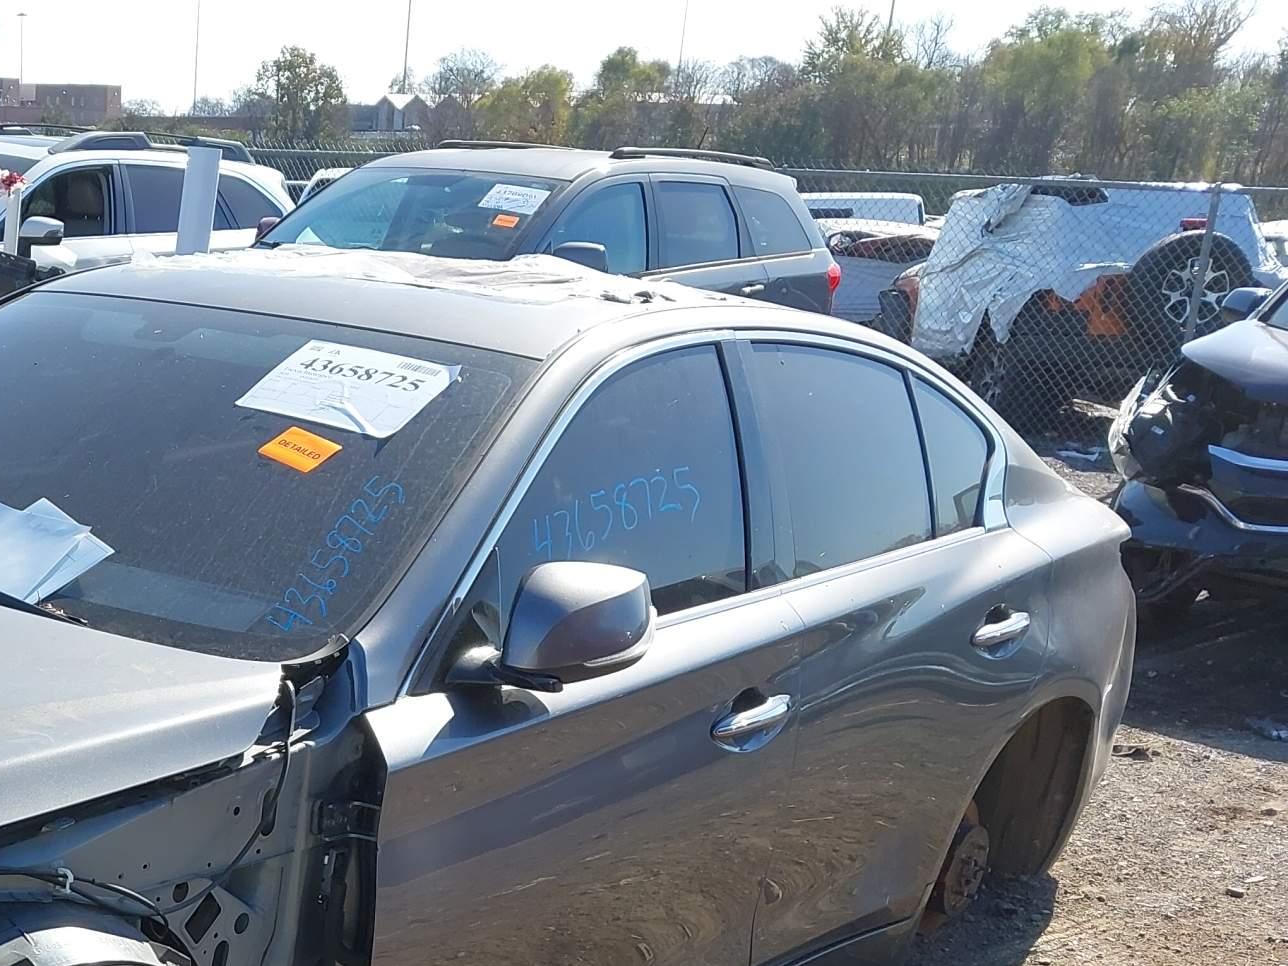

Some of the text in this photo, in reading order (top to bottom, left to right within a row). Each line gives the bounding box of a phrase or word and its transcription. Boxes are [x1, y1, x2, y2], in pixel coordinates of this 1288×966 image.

[300, 357, 427, 392] 43658725
[277, 438, 321, 461] DETAILED
[534, 466, 701, 560] 43658725
[265, 475, 406, 632] 43658725
